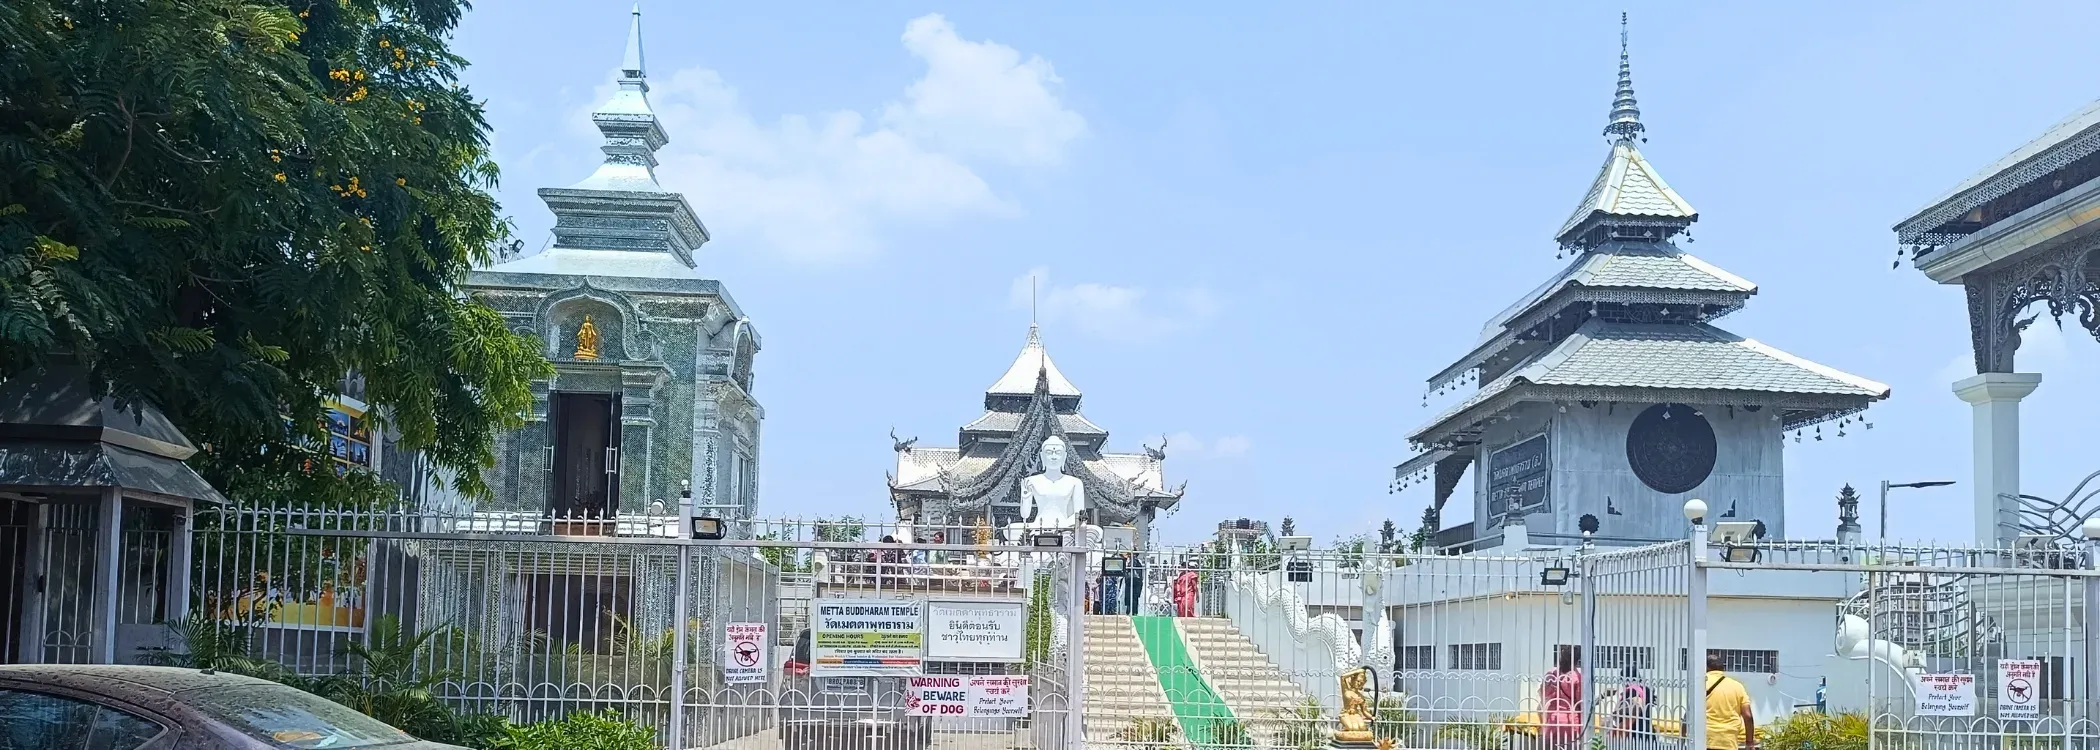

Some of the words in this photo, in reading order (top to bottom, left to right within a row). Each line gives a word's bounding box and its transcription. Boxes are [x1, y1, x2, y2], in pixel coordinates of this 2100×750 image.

[821, 607, 843, 615] METTA
[846, 607, 889, 615] BUDDHARAM
[891, 607, 918, 616] TEMPLE
[825, 618, 914, 632] วัดเมตตาพุทธาราม
[911, 678, 960, 687] WARNING
[923, 691, 965, 701] BEWARE
[922, 705, 937, 713] OF
[941, 705, 963, 713] DOG
